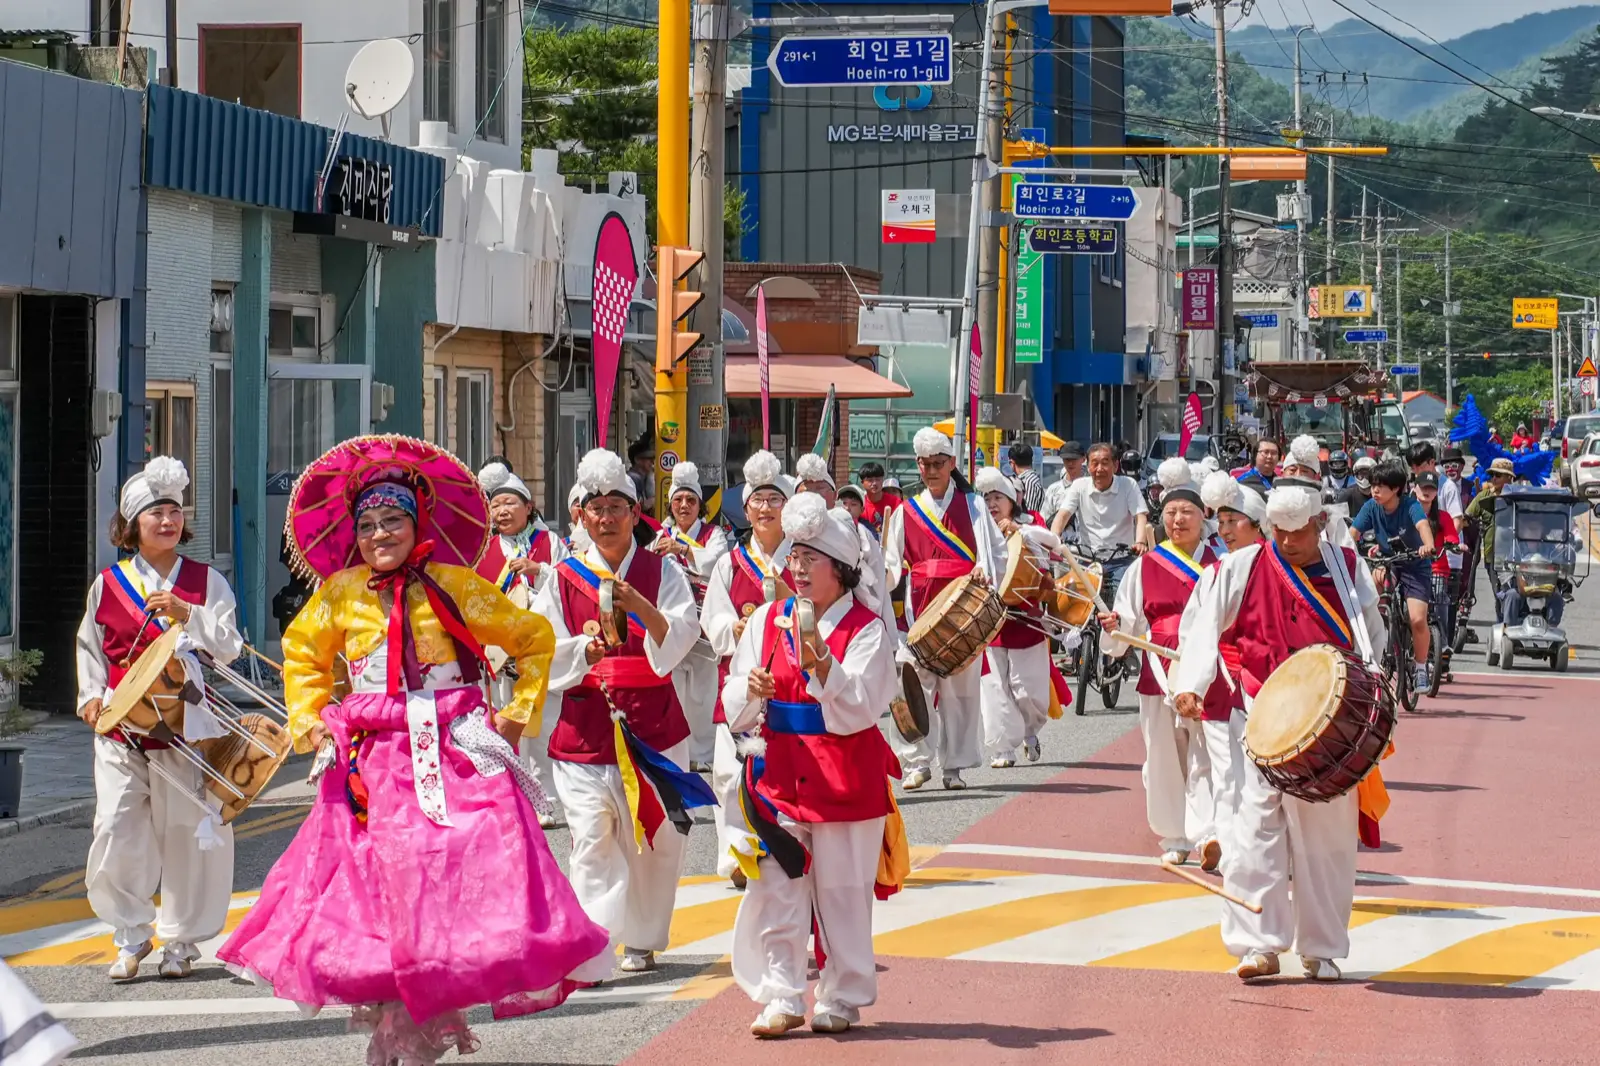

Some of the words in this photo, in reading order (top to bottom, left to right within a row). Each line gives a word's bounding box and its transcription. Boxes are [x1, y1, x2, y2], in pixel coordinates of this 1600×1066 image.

[783, 51, 801, 62] 291
[848, 40, 944, 62] 회인로1길
[847, 67, 907, 80] Hoein-ro
[912, 66, 944, 81] 1-gil
[340, 157, 393, 224] 진미식당
[1020, 186, 1086, 204] 회인로2길
[901, 204, 931, 214] 우체국
[1020, 204, 1060, 215] Hoein-ro
[1064, 205, 1086, 217] 2-gil
[1035, 228, 1113, 244] 회인초등학교
[1187, 272, 1210, 283] 우리
[1190, 284, 1207, 321] 미용실
[662, 456, 676, 467] 30
